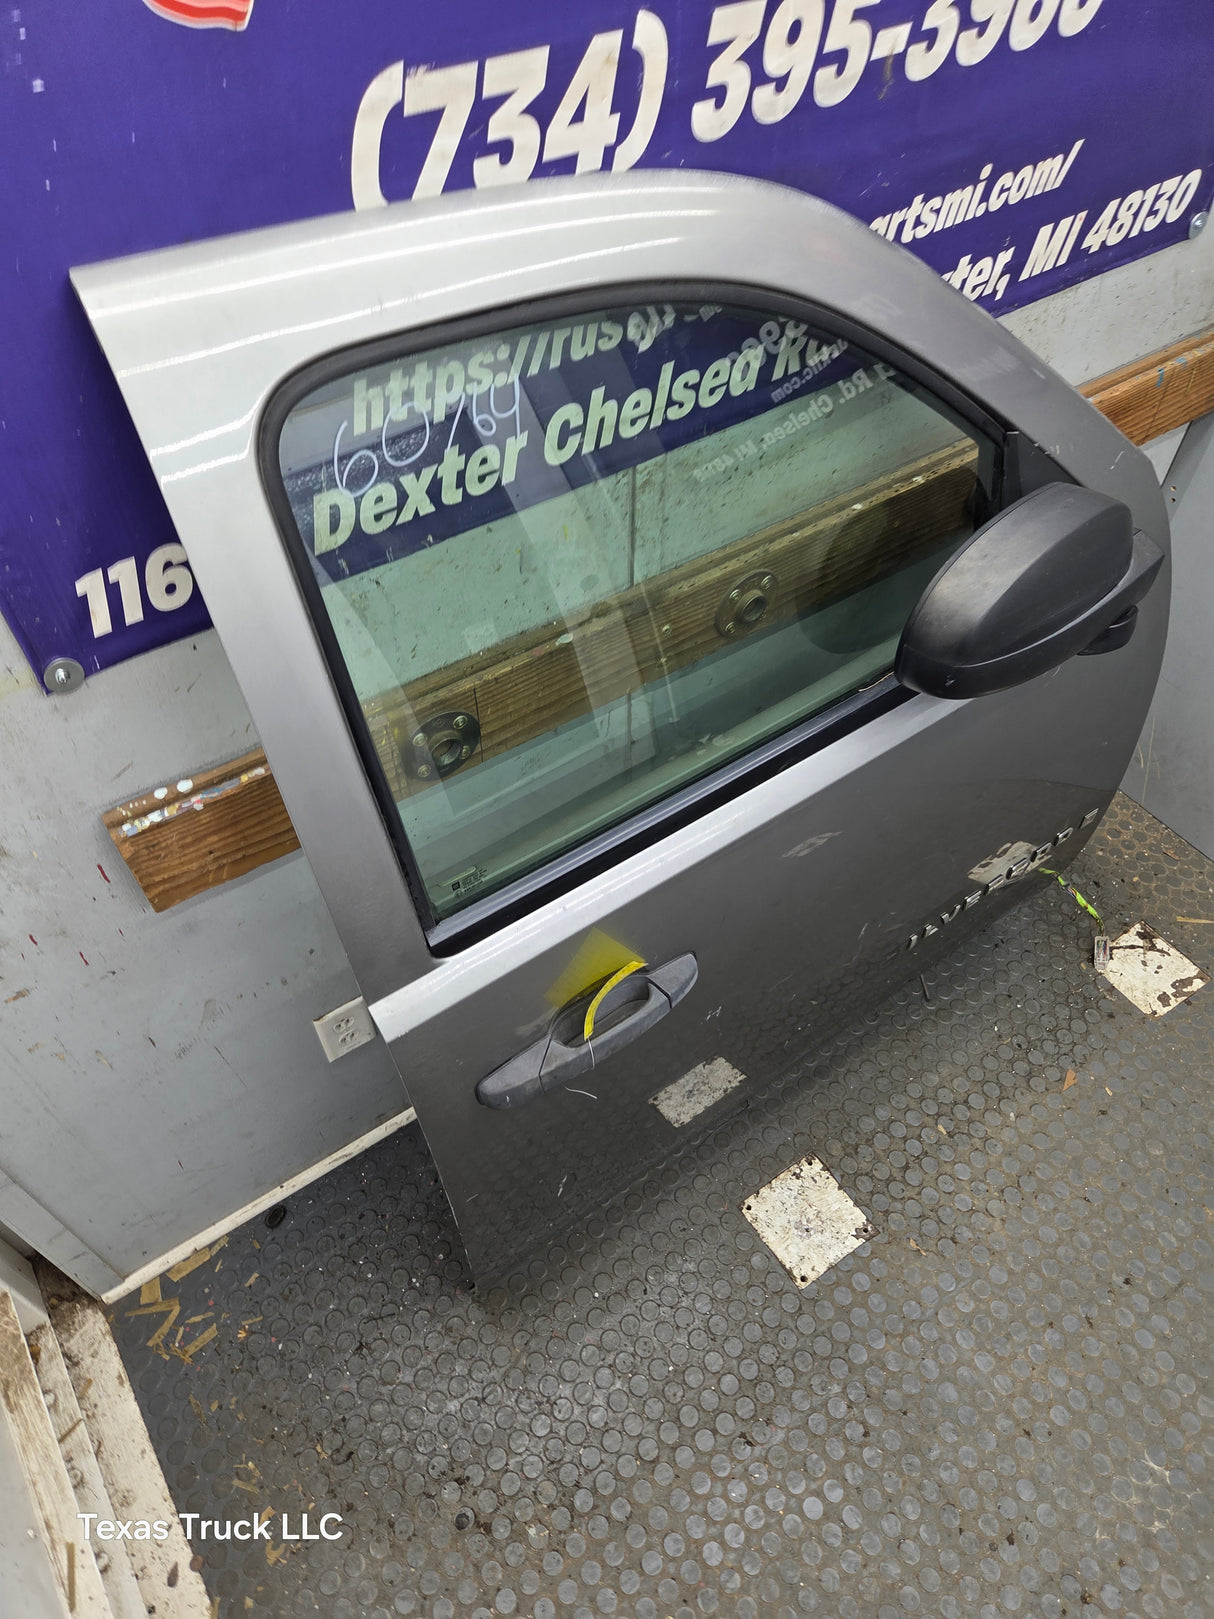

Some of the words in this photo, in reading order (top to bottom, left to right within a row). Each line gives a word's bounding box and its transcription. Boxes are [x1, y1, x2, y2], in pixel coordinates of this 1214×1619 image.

[350, 9, 668, 212] (734)
[690, 0, 1104, 143] 395-39
[313, 431, 529, 557] Dexter
[544, 344, 767, 466] Chelsea
[1018, 209, 1089, 282] MI
[1081, 168, 1202, 254] 48130
